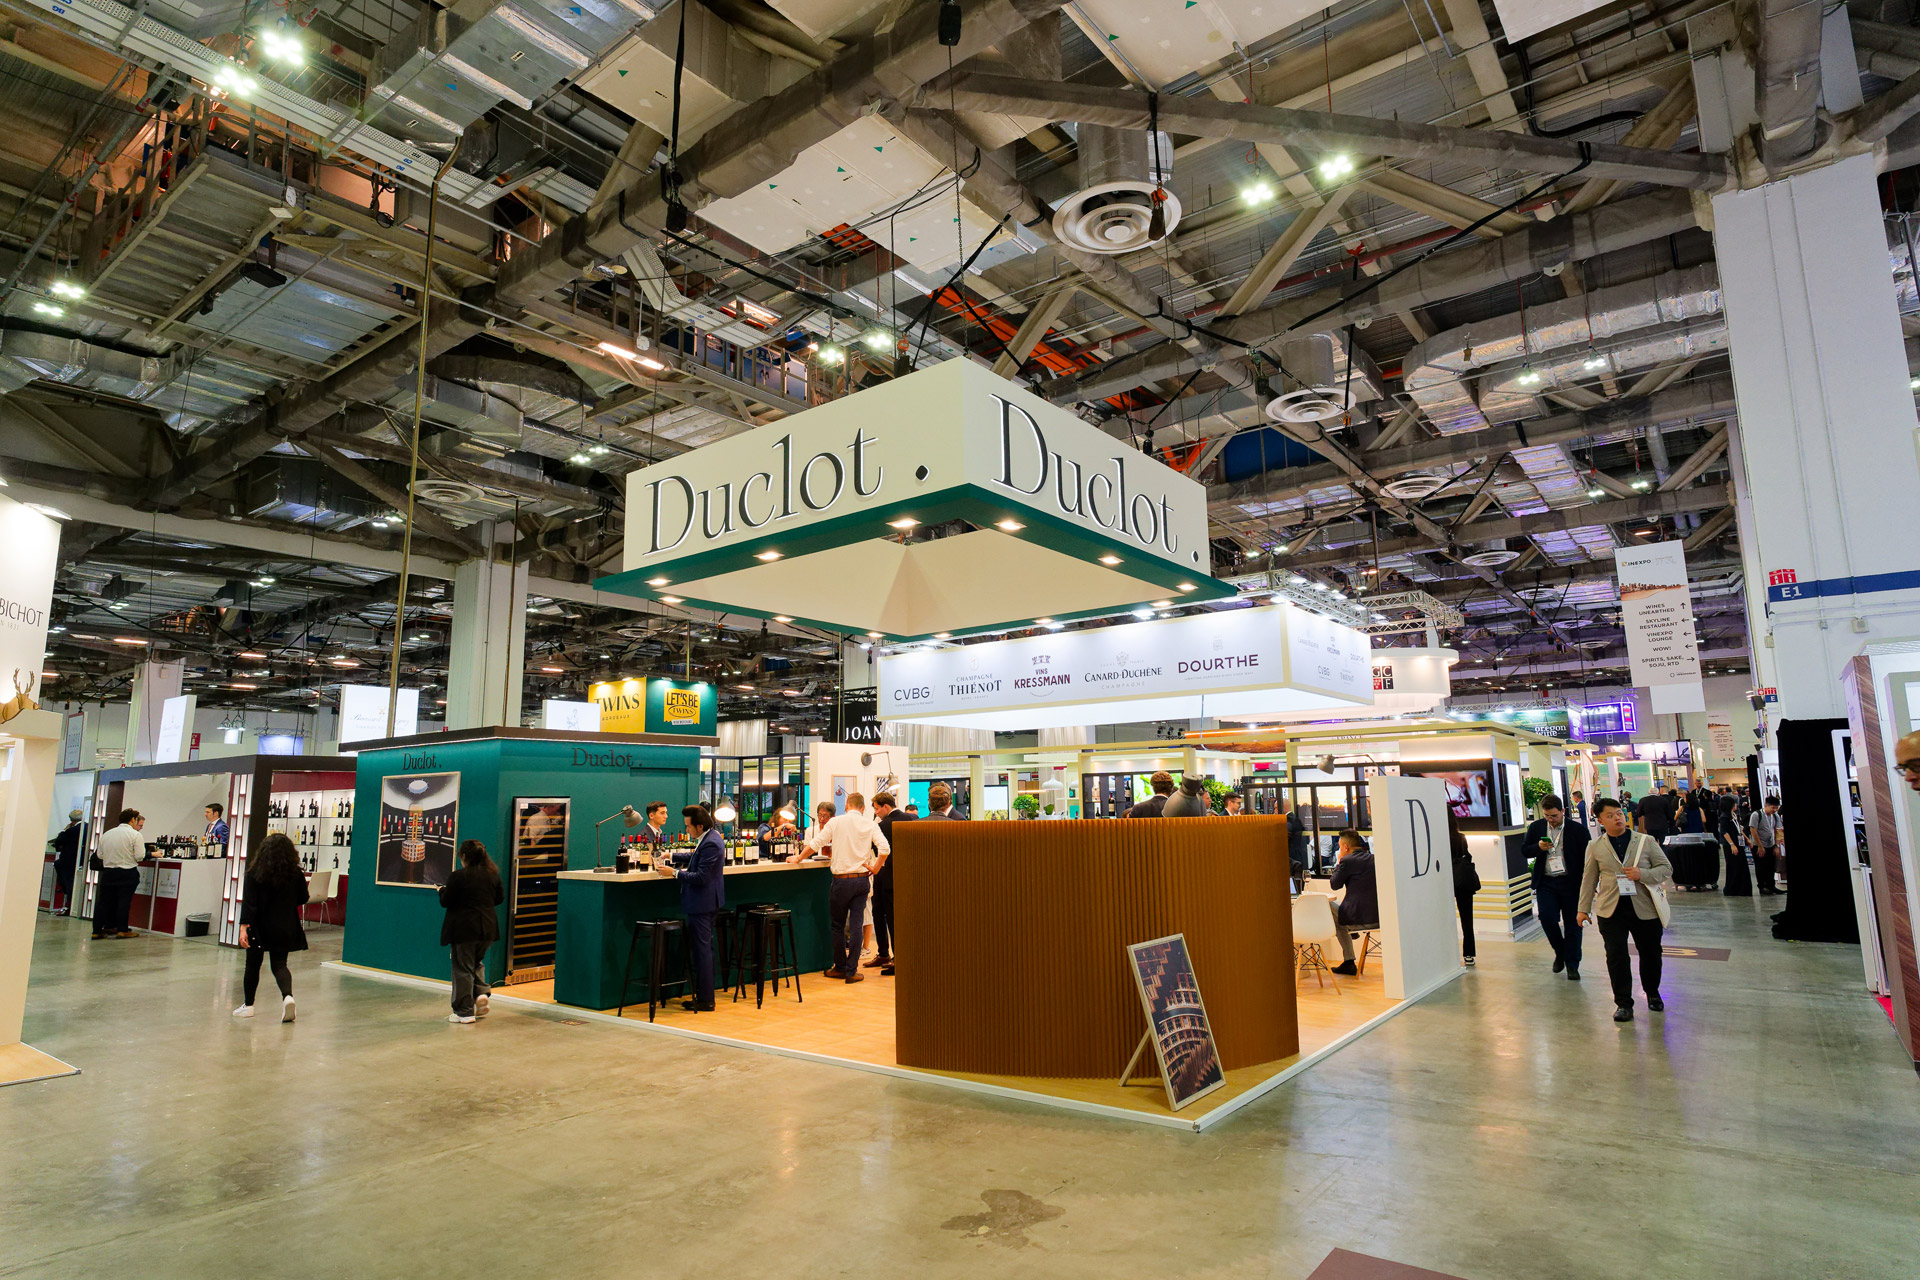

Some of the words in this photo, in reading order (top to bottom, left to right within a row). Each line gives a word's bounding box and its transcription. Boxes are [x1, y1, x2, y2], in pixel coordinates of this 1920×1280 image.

[1781, 586, 1802, 598] E1
[1638, 607, 1675, 615] UNEARTHED
[1639, 621, 1678, 630] RESTAURANT
[1178, 654, 1259, 673] DOURTHE
[956, 673, 993, 682] CHAMPAGNE
[1014, 674, 1071, 689] KRESSMANN
[948, 680, 1002, 695] THIÉNOT
[1101, 682, 1145, 690] CHAMPAGNE
[666, 692, 688, 706] LET'S
[689, 694, 698, 708] BE
[845, 723, 905, 740] JOANNE
[1534, 725, 1567, 734] oregon
